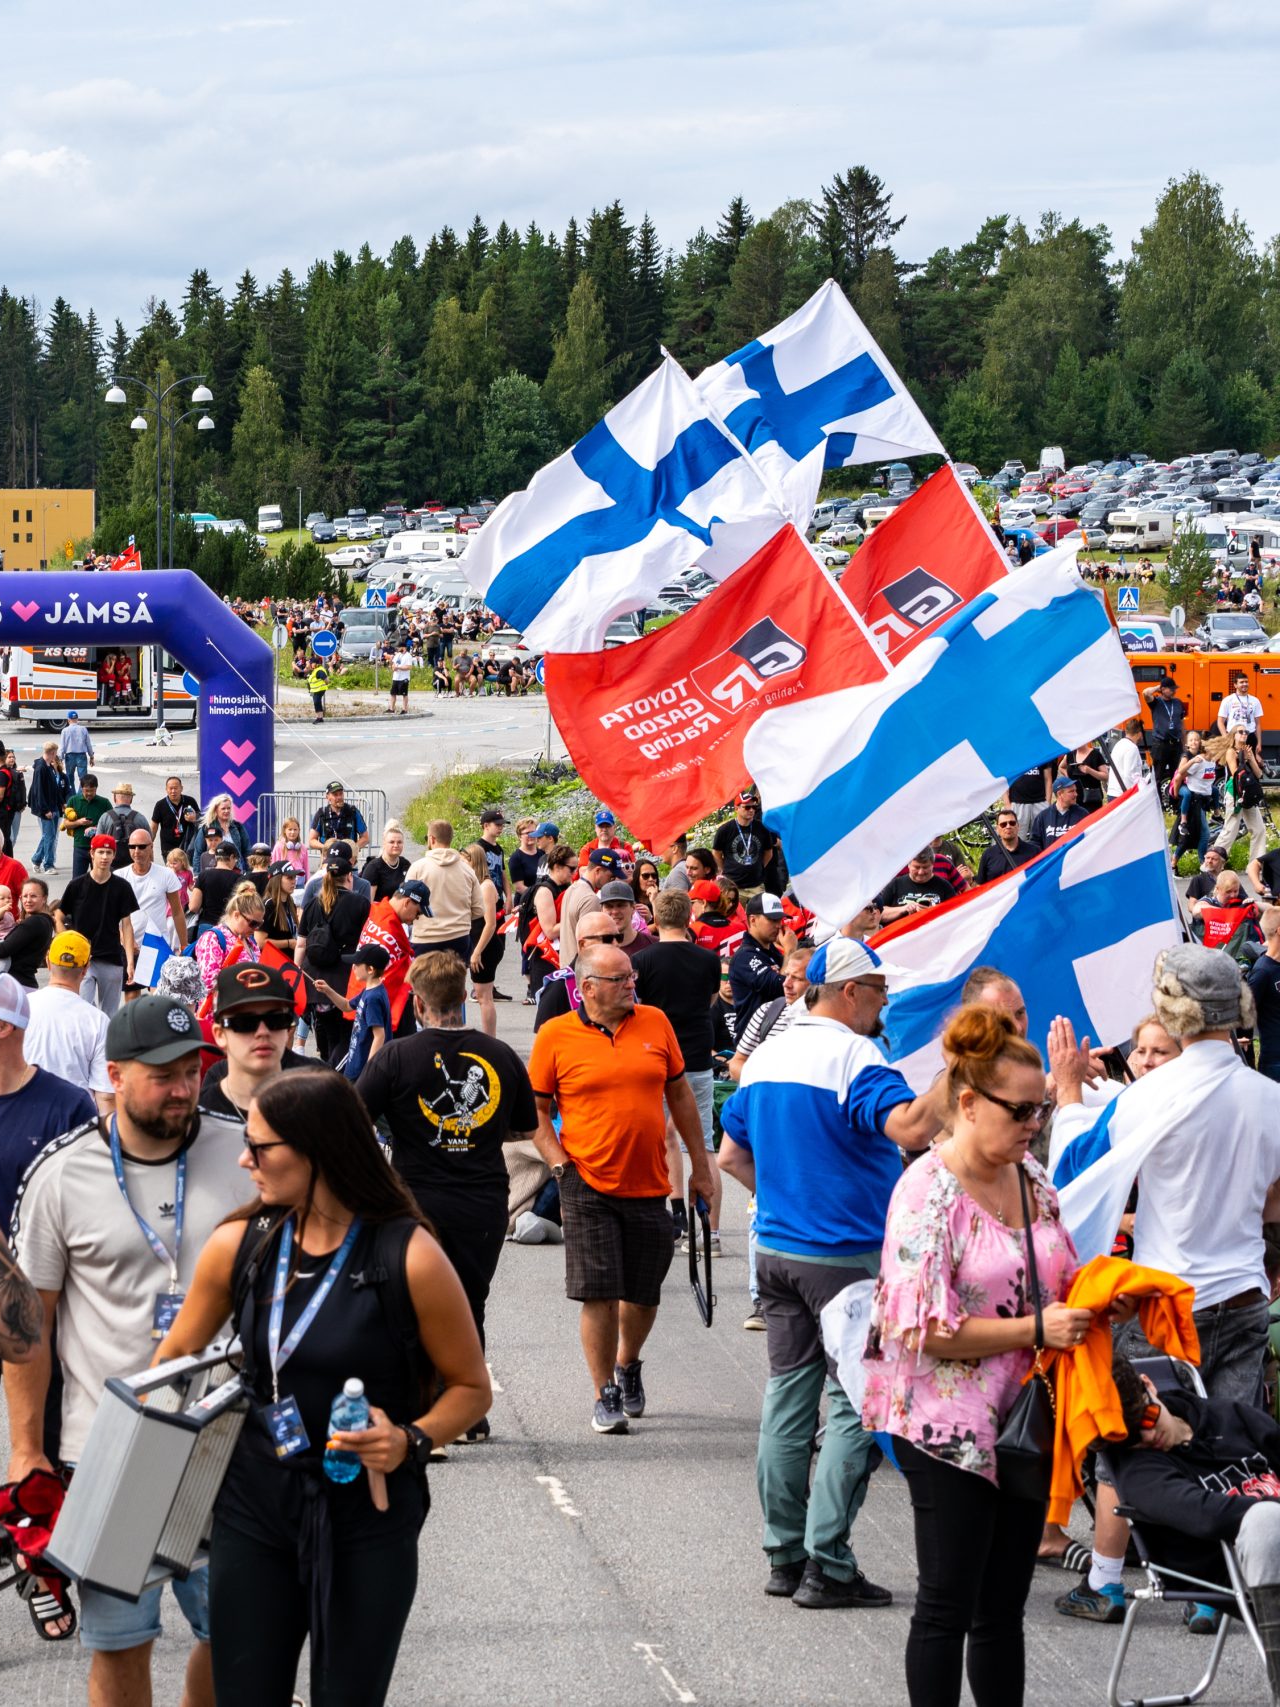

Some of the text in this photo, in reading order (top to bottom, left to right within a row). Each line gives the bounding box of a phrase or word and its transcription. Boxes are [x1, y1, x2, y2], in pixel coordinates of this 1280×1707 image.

[44, 591, 153, 624] JÄMSÄ
[44, 648, 87, 656] KS 835
[209, 695, 267, 705] #himosjämsä
[209, 705, 267, 716] himosjamsa.fi
